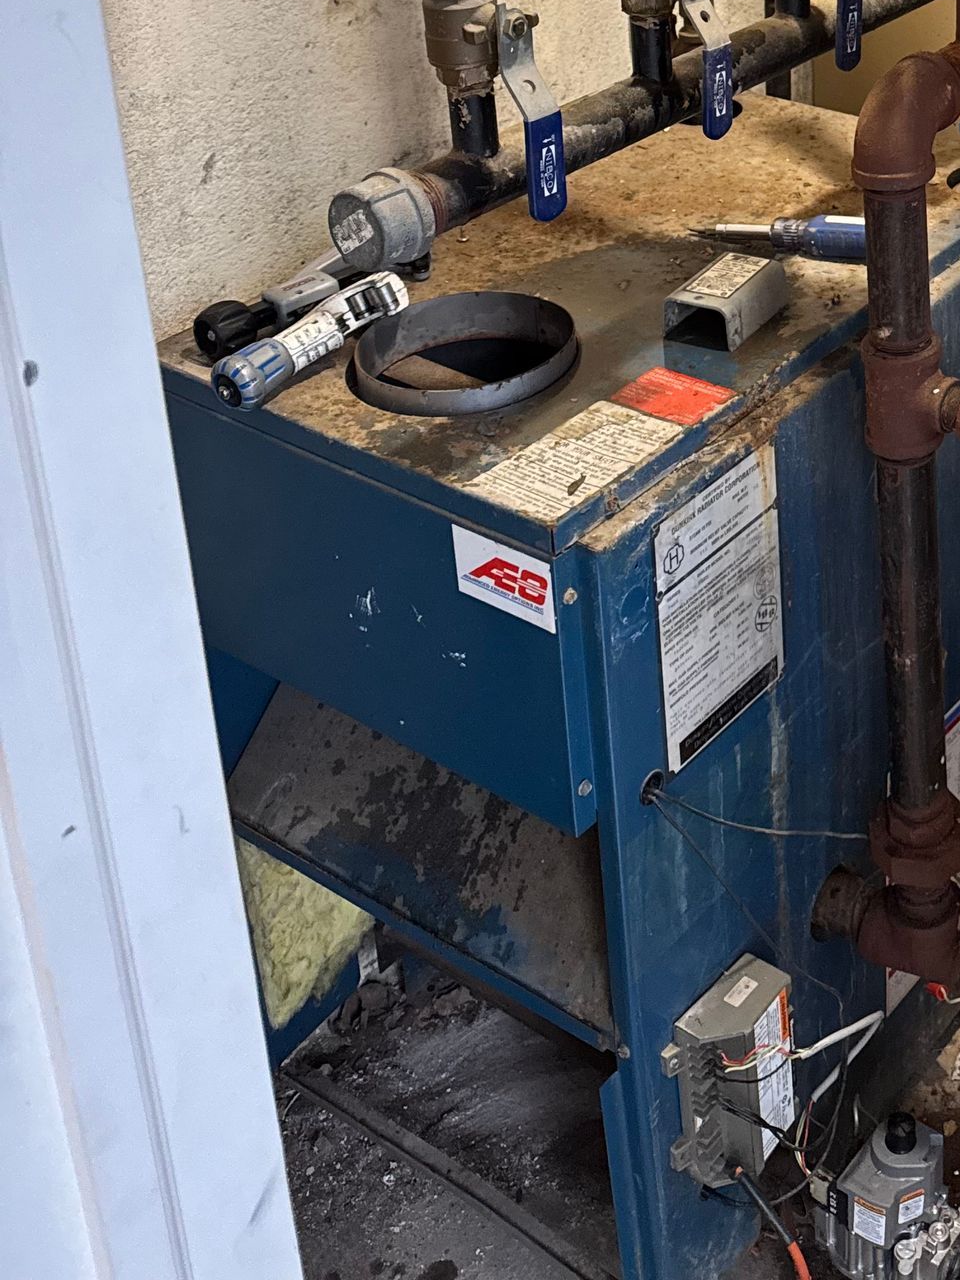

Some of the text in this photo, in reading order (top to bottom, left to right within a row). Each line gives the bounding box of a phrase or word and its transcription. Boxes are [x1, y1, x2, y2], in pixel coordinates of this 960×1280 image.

[716, 73, 724, 113] NIBCO
[543, 148, 555, 192] NIBCO
[697, 490, 723, 515] RADIATOR
[724, 461, 760, 494] CORPORATION
